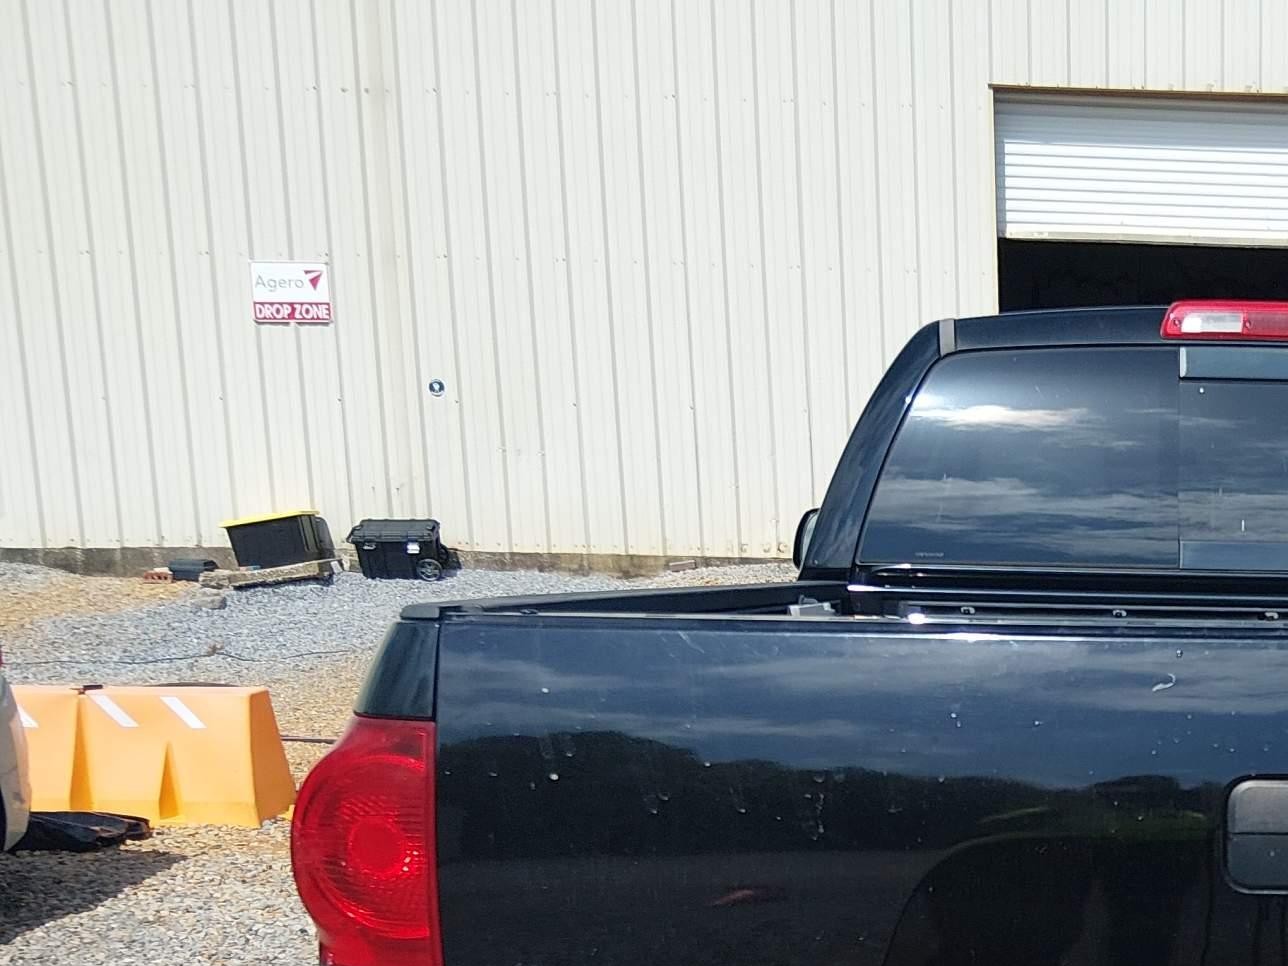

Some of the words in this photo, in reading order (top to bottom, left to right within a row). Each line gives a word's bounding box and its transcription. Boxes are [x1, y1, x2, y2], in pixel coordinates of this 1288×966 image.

[255, 274, 304, 292] Agero
[254, 303, 292, 319] DROP
[293, 303, 330, 319] ZONE
